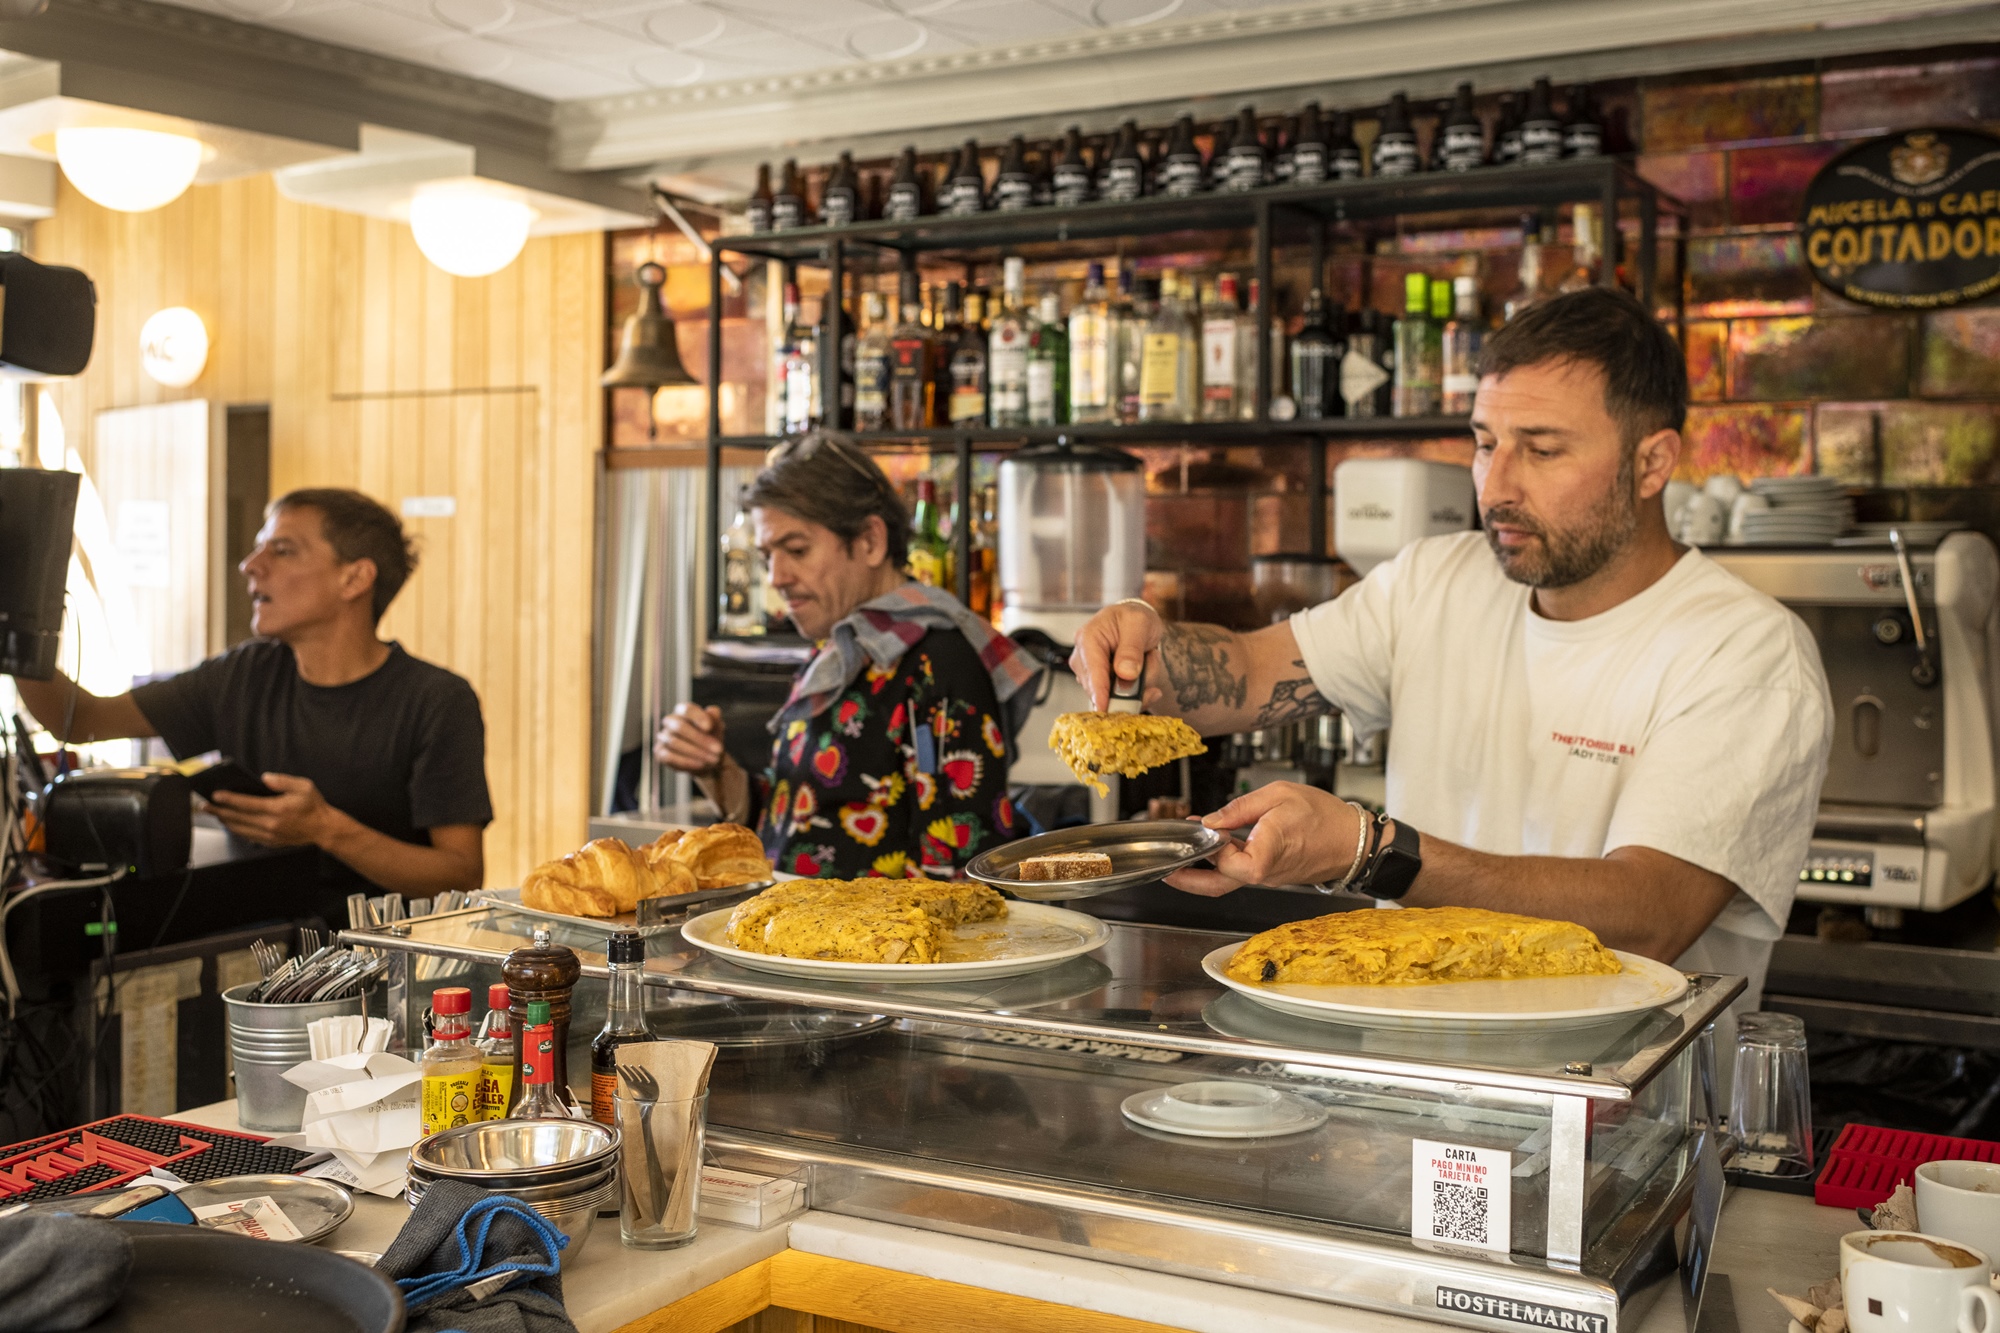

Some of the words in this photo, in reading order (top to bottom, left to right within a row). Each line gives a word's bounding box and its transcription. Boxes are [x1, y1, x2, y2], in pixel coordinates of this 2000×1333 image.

[1939, 190, 2000, 215] CAF
[1445, 1148, 1477, 1162] CARTA
[1431, 1159, 1453, 1170] PAGO
[1456, 1162, 1487, 1175] MINIMO
[1439, 1169, 1471, 1182] TARJETA
[1437, 1289, 1605, 1333] HOSTELMARKT
